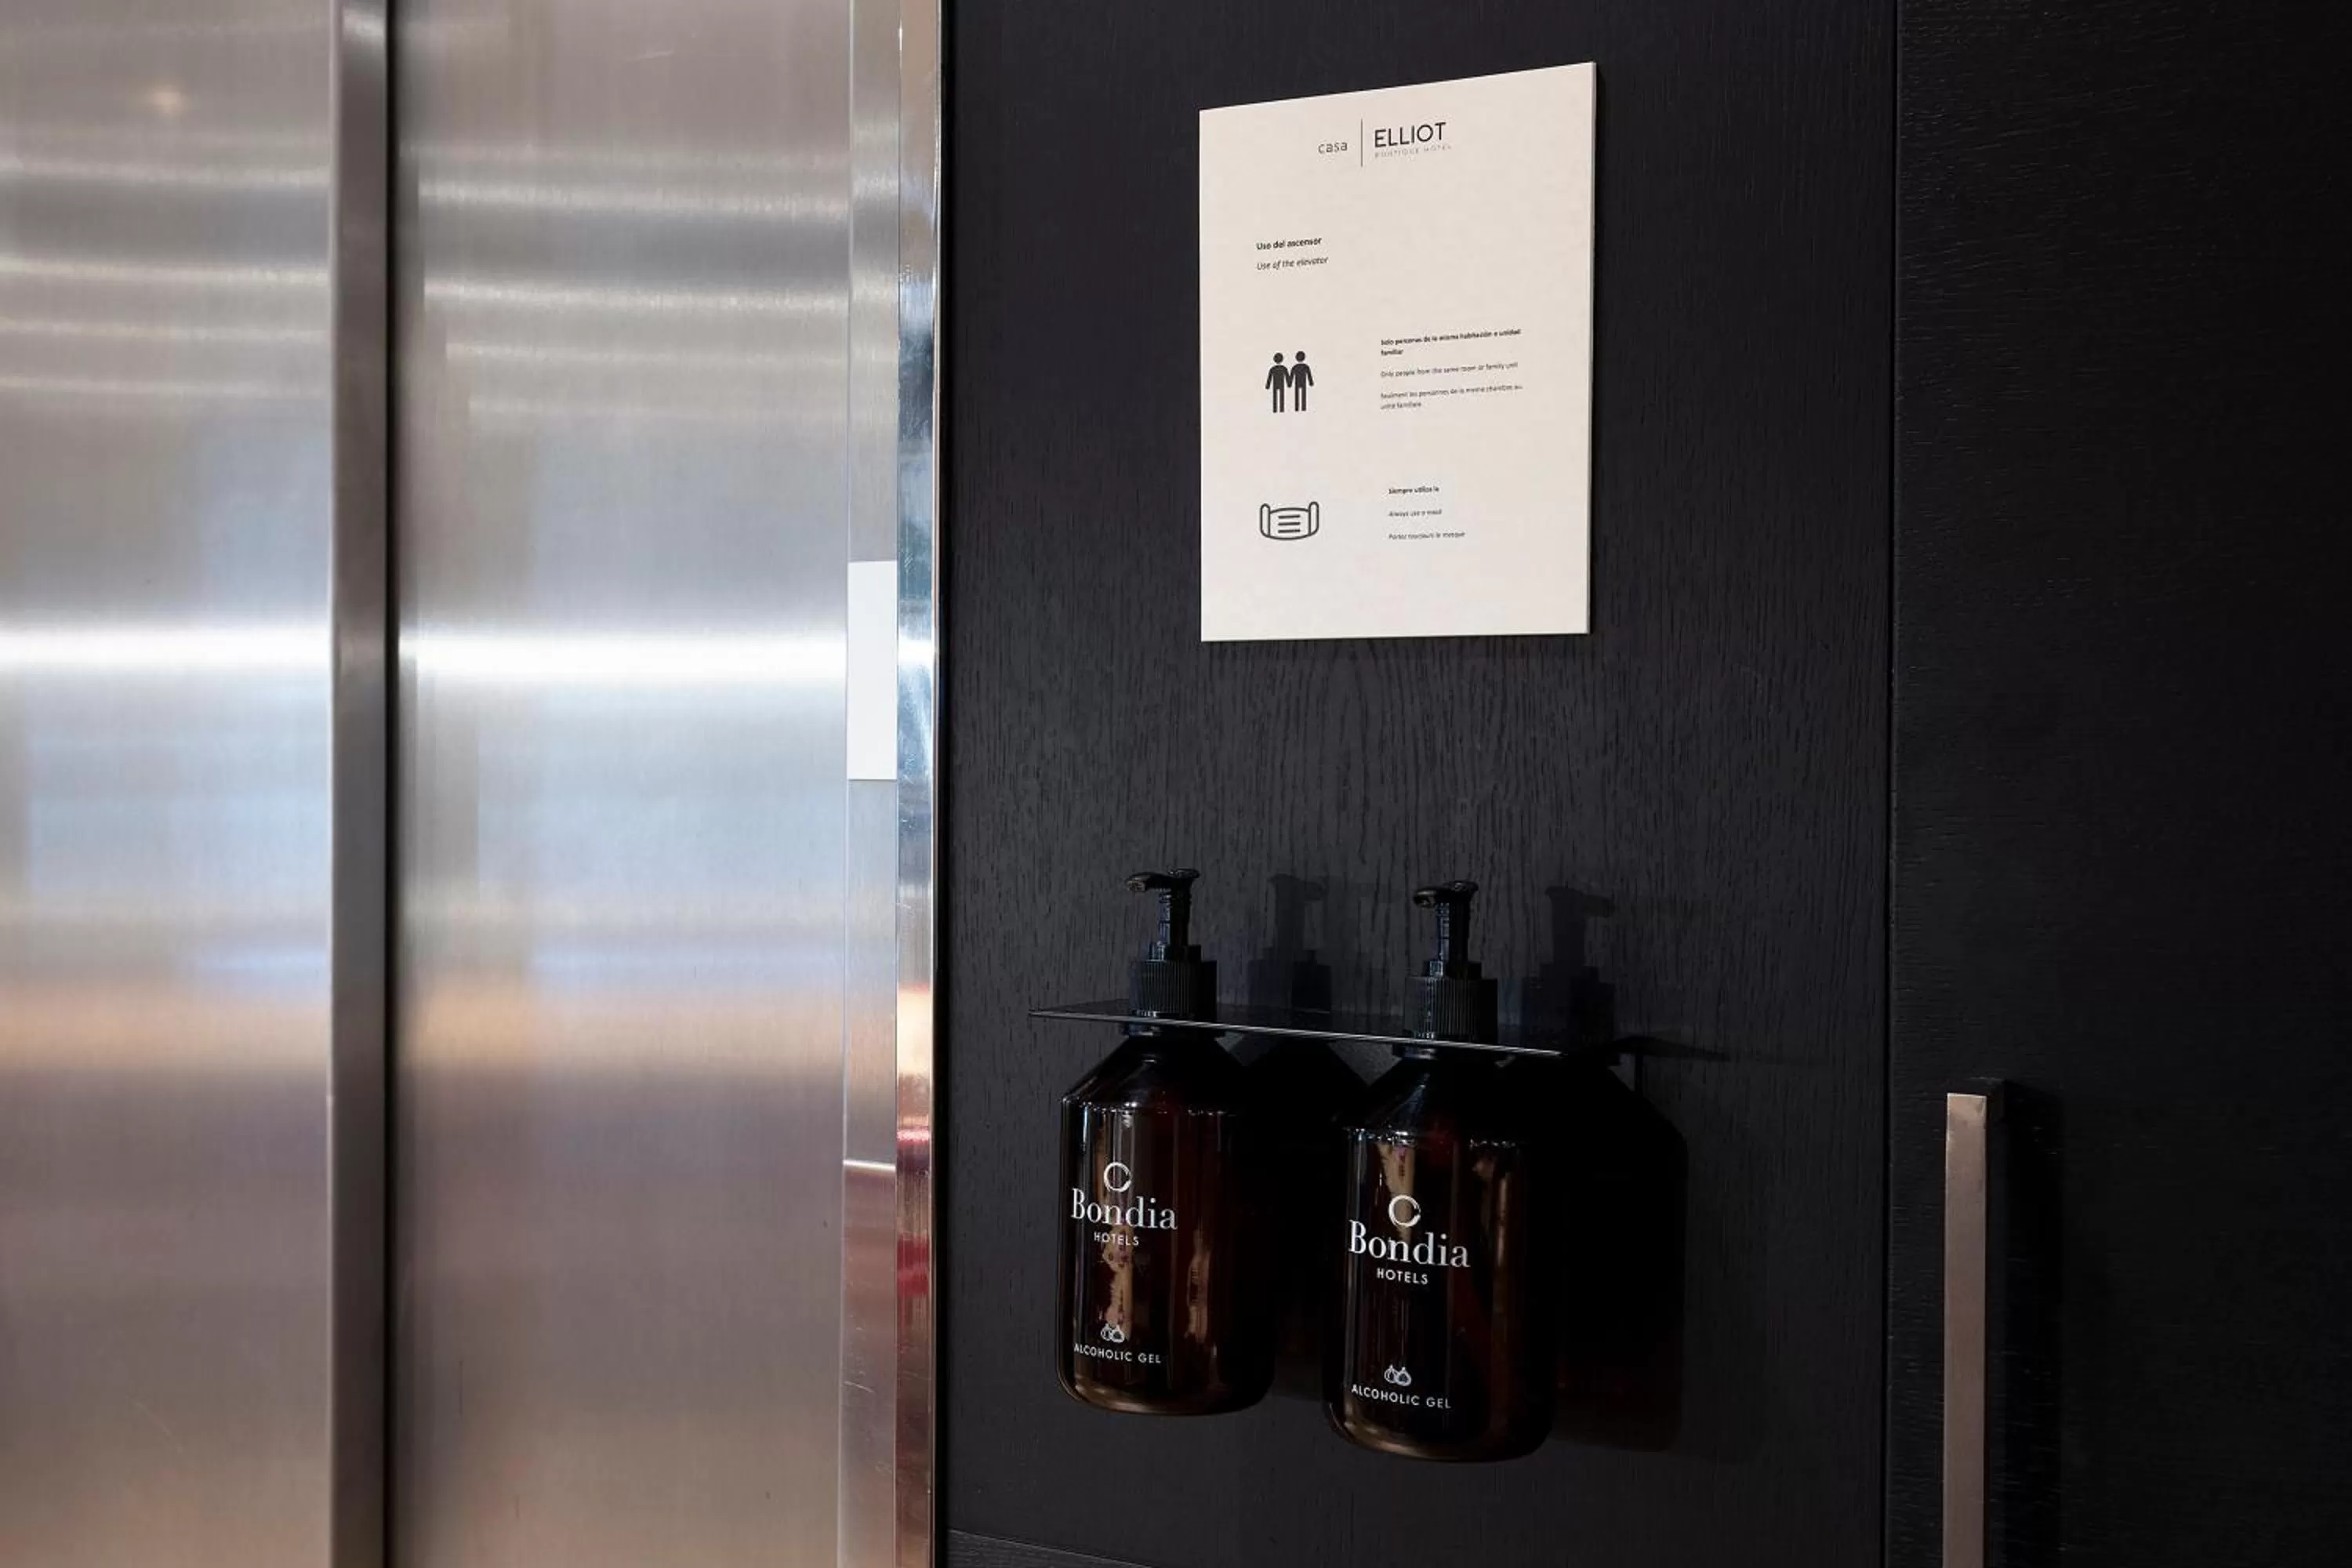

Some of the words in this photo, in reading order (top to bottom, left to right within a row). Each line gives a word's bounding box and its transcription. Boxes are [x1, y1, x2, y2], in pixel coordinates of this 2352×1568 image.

[1317, 141, 1348, 154] casa
[1374, 122, 1446, 148] ELLIOT
[1272, 239, 1286, 249] del
[1287, 238, 1323, 247] ascensor
[1272, 260, 1281, 270] of
[1071, 1188, 1178, 1230] Bondia
[1094, 1232, 1139, 1247] HOTELS
[1348, 1219, 1471, 1268] Bondia
[1377, 1268, 1428, 1285] HOTELS
[1073, 1343, 1132, 1362] ALCOHOLIC
[1138, 1352, 1161, 1363] GEL
[1351, 1384, 1420, 1406] ALCOHOLIC
[1426, 1396, 1451, 1409] GEL
